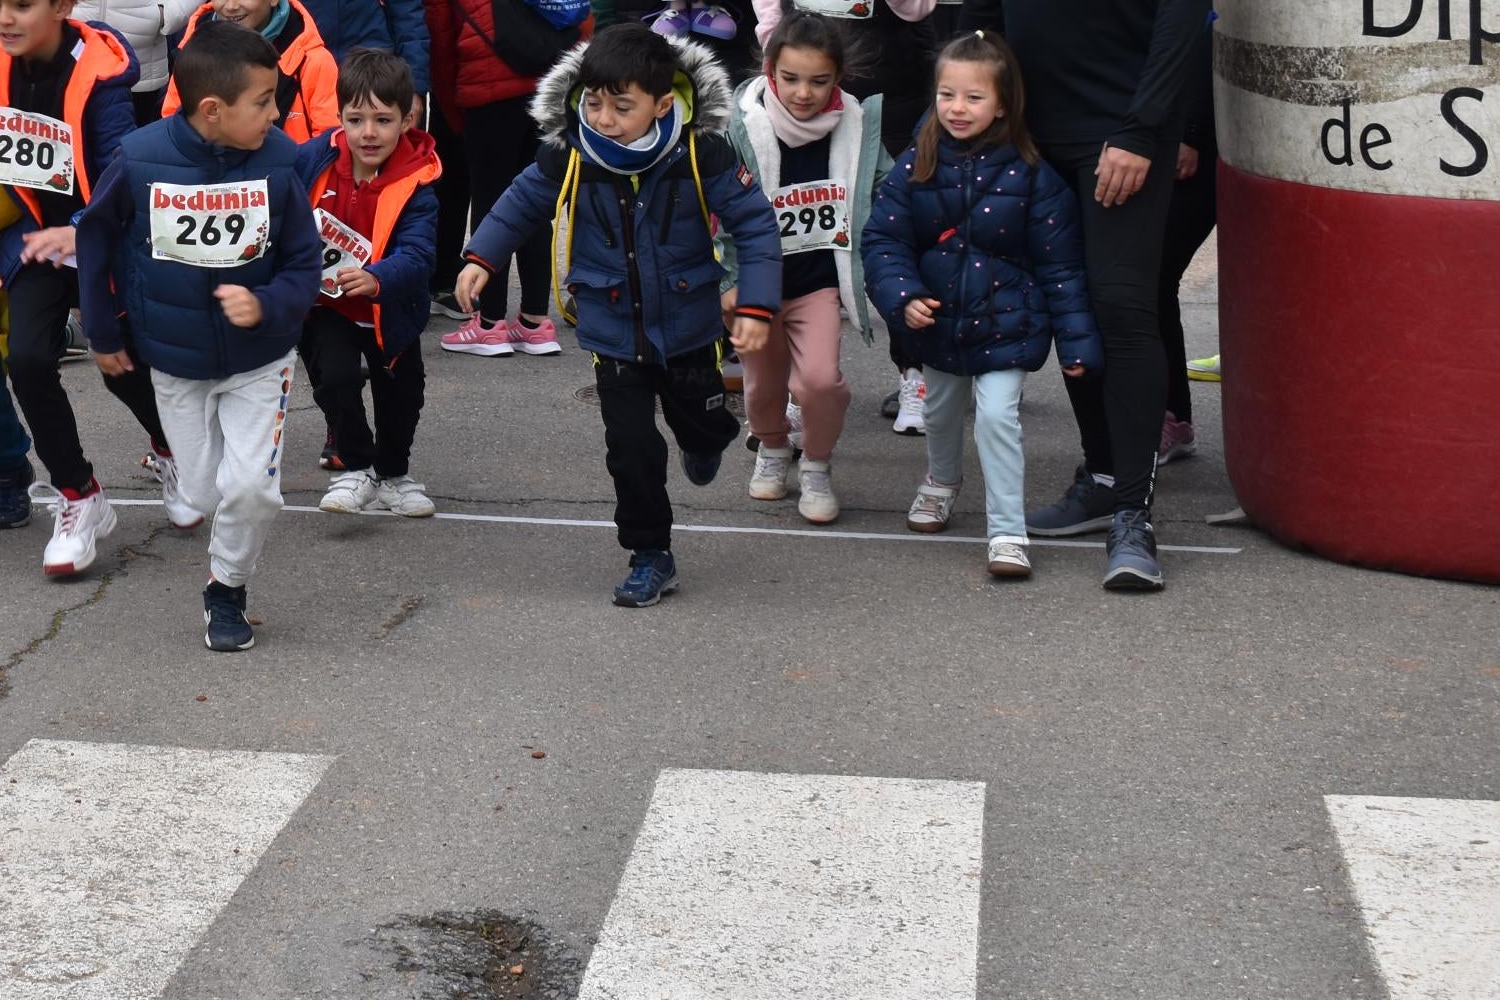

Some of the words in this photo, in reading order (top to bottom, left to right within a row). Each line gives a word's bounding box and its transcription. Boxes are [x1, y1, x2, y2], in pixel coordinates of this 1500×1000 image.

[1319, 97, 1393, 171] de
[1438, 86, 1490, 178] S
[153, 187, 266, 211] bedunia
[175, 213, 246, 246] 269
[778, 204, 836, 238] 298
